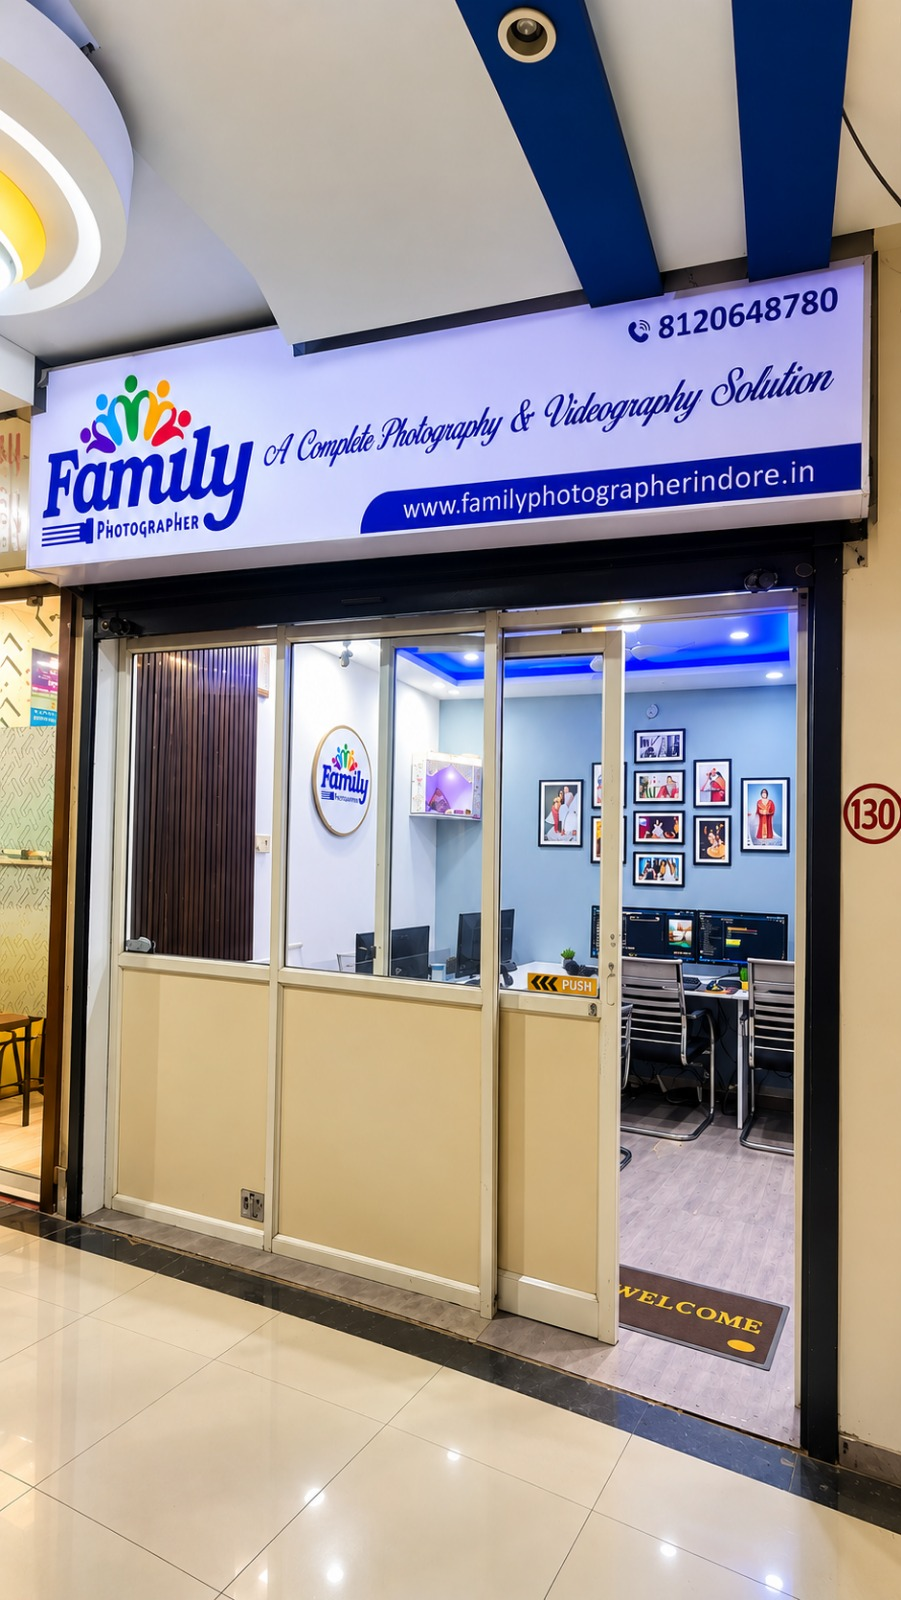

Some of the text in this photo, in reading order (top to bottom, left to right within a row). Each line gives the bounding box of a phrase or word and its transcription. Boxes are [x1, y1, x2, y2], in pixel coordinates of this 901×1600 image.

[658, 286, 838, 339] 8120648780
[263, 361, 835, 467] A Complete Photography & Videography Solution
[42, 425, 254, 531] Family
[403, 460, 815, 518] www.familyphotographerindore.in
[321, 764, 369, 805] Family
[850, 798, 895, 830] 130
[561, 979, 592, 992] PUSH
[618, 1284, 763, 1335] WELCOME
